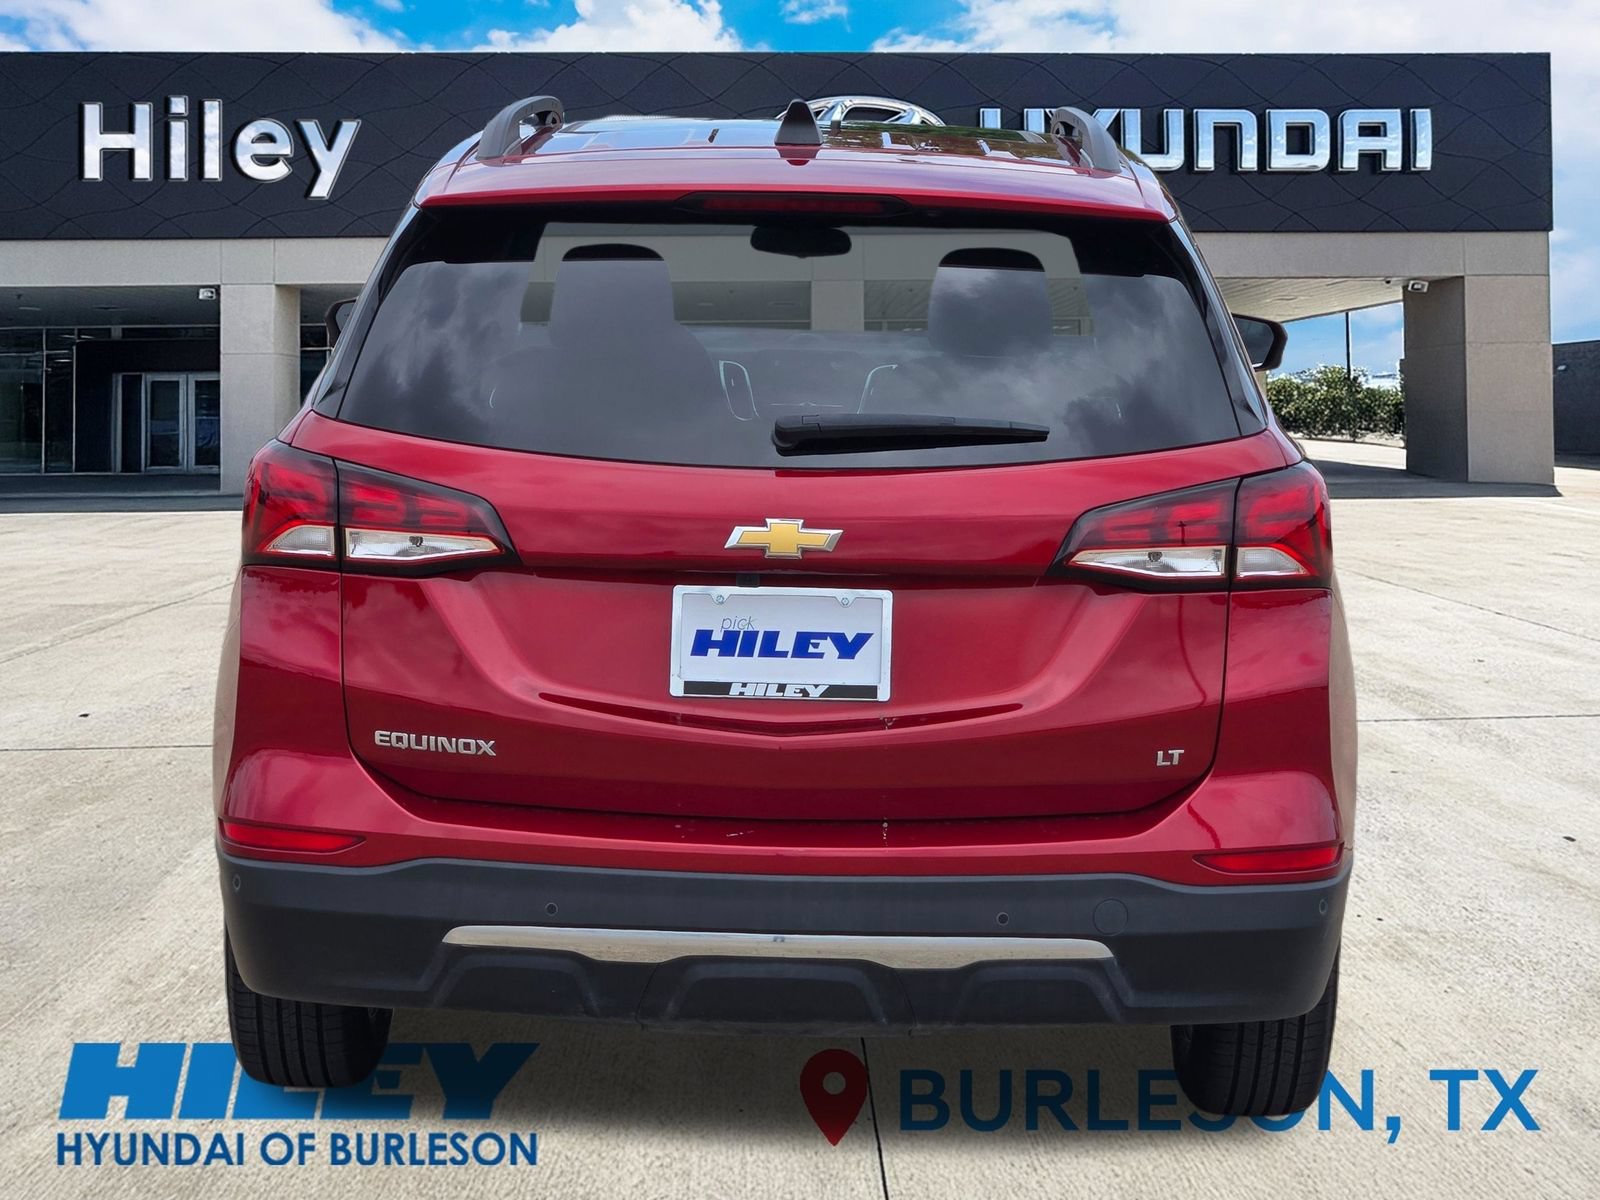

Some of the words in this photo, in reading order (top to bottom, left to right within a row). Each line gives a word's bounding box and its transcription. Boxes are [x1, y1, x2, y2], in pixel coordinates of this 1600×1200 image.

[81, 95, 361, 200] Hiley
[720, 615, 757, 632] pick
[690, 629, 874, 660] HILEY
[728, 682, 830, 698] HILEY
[374, 730, 497, 757] EQUINOX
[1156, 749, 1185, 767] LT
